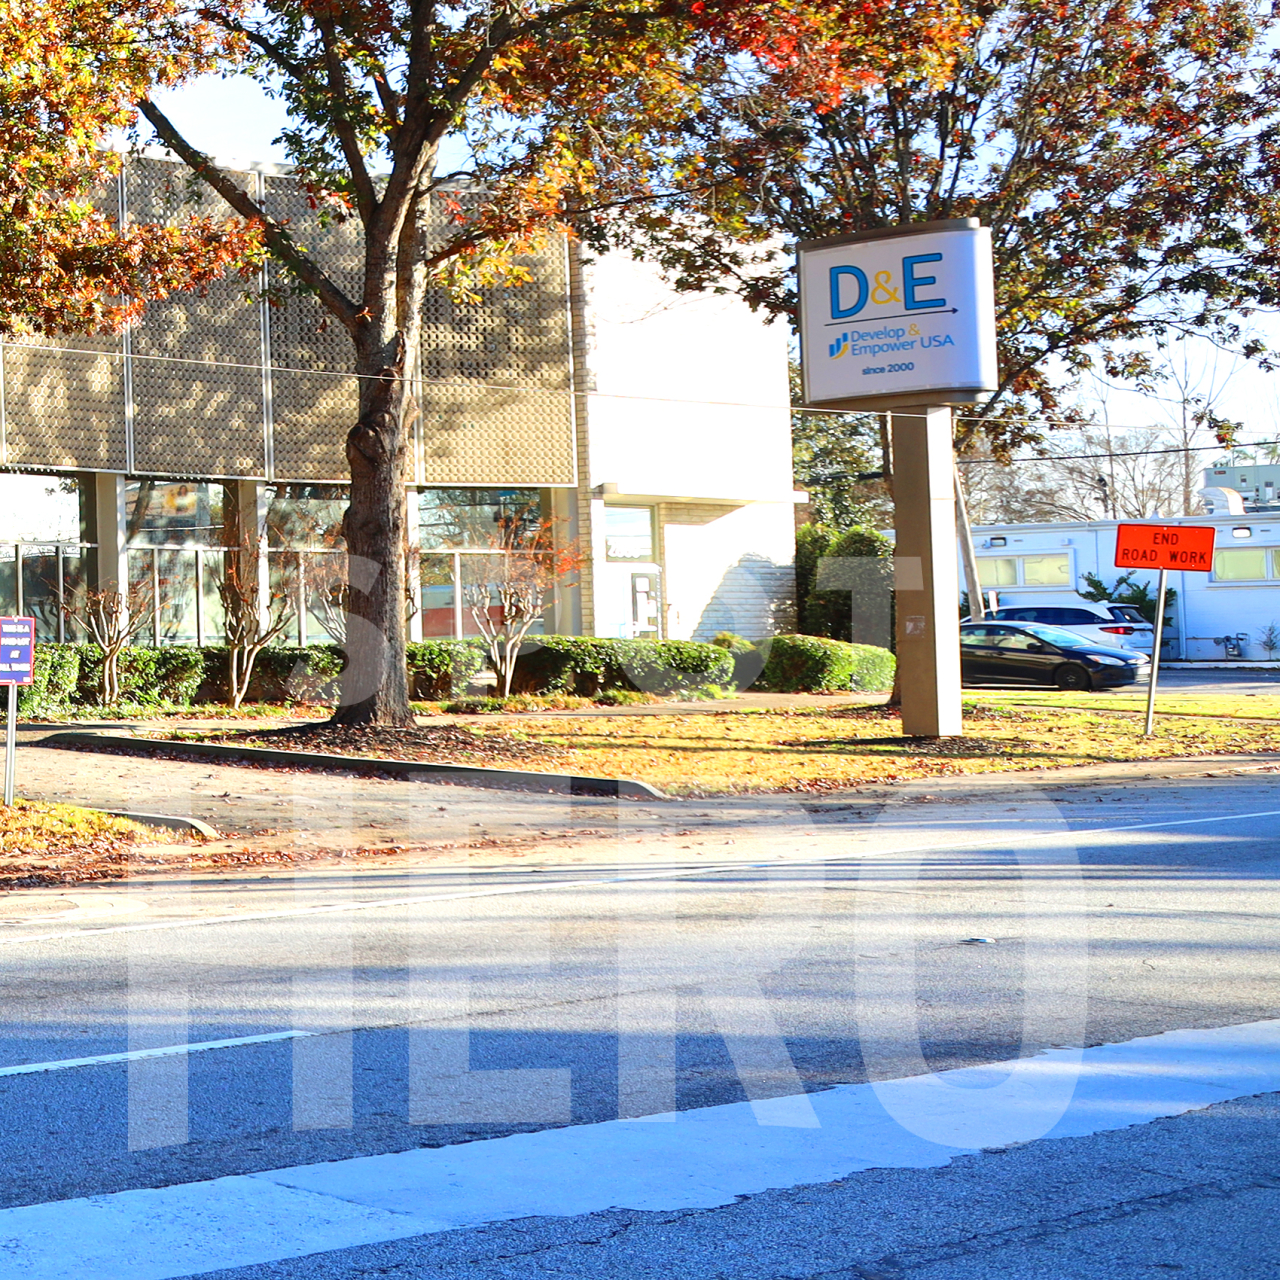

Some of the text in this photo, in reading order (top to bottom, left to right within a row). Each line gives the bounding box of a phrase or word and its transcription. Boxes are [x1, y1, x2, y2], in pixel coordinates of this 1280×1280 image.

[829, 252, 946, 320] D&E
[851, 323, 921, 342] Develop &
[851, 334, 955, 357] Empower USA
[861, 362, 914, 376] since 2000
[1153, 532, 1179, 545] END
[1121, 548, 1207, 564] ROAD WORK
